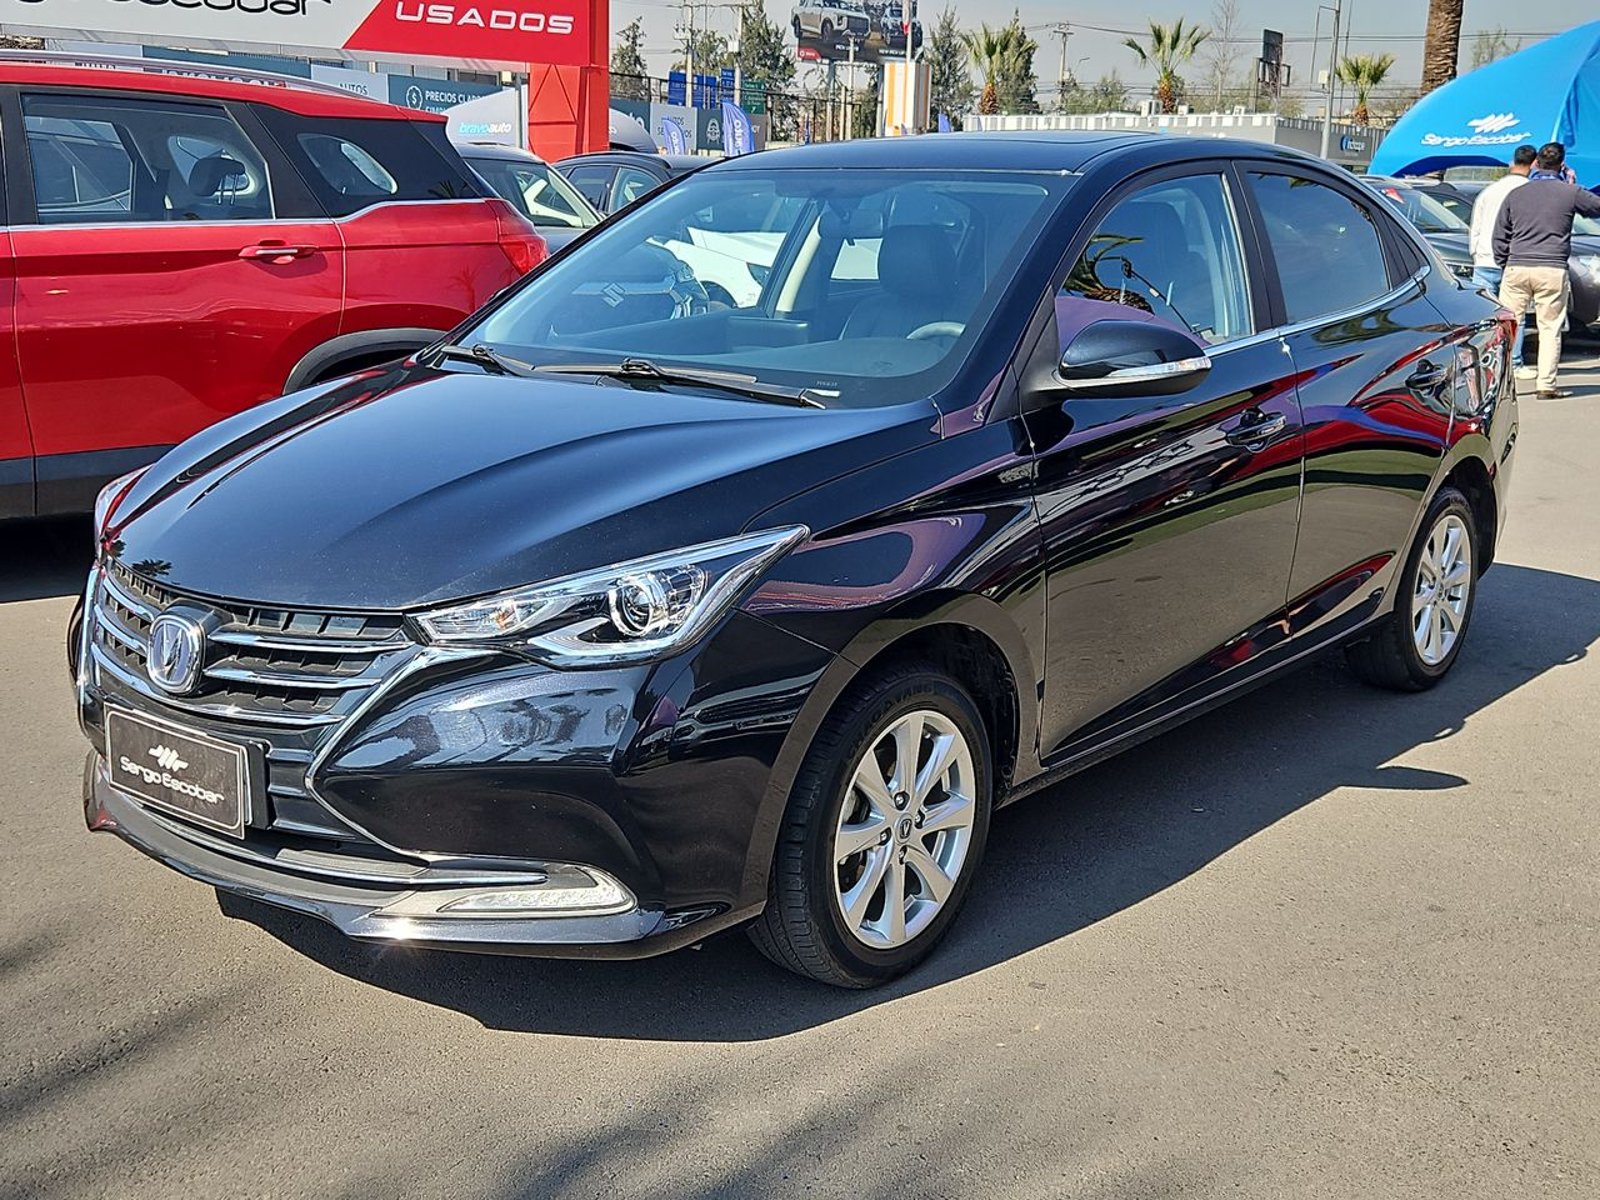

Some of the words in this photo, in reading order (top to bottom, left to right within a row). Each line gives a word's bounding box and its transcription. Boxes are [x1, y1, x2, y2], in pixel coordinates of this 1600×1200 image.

[395, 1, 575, 35] USADOS
[425, 90, 457, 103] PRECIOS
[459, 122, 512, 133] bravoauto
[1420, 133, 1467, 147] Sergo
[1467, 132, 1532, 145] Escobar
[120, 756, 162, 784] Sergo
[162, 773, 225, 804] Escobar
